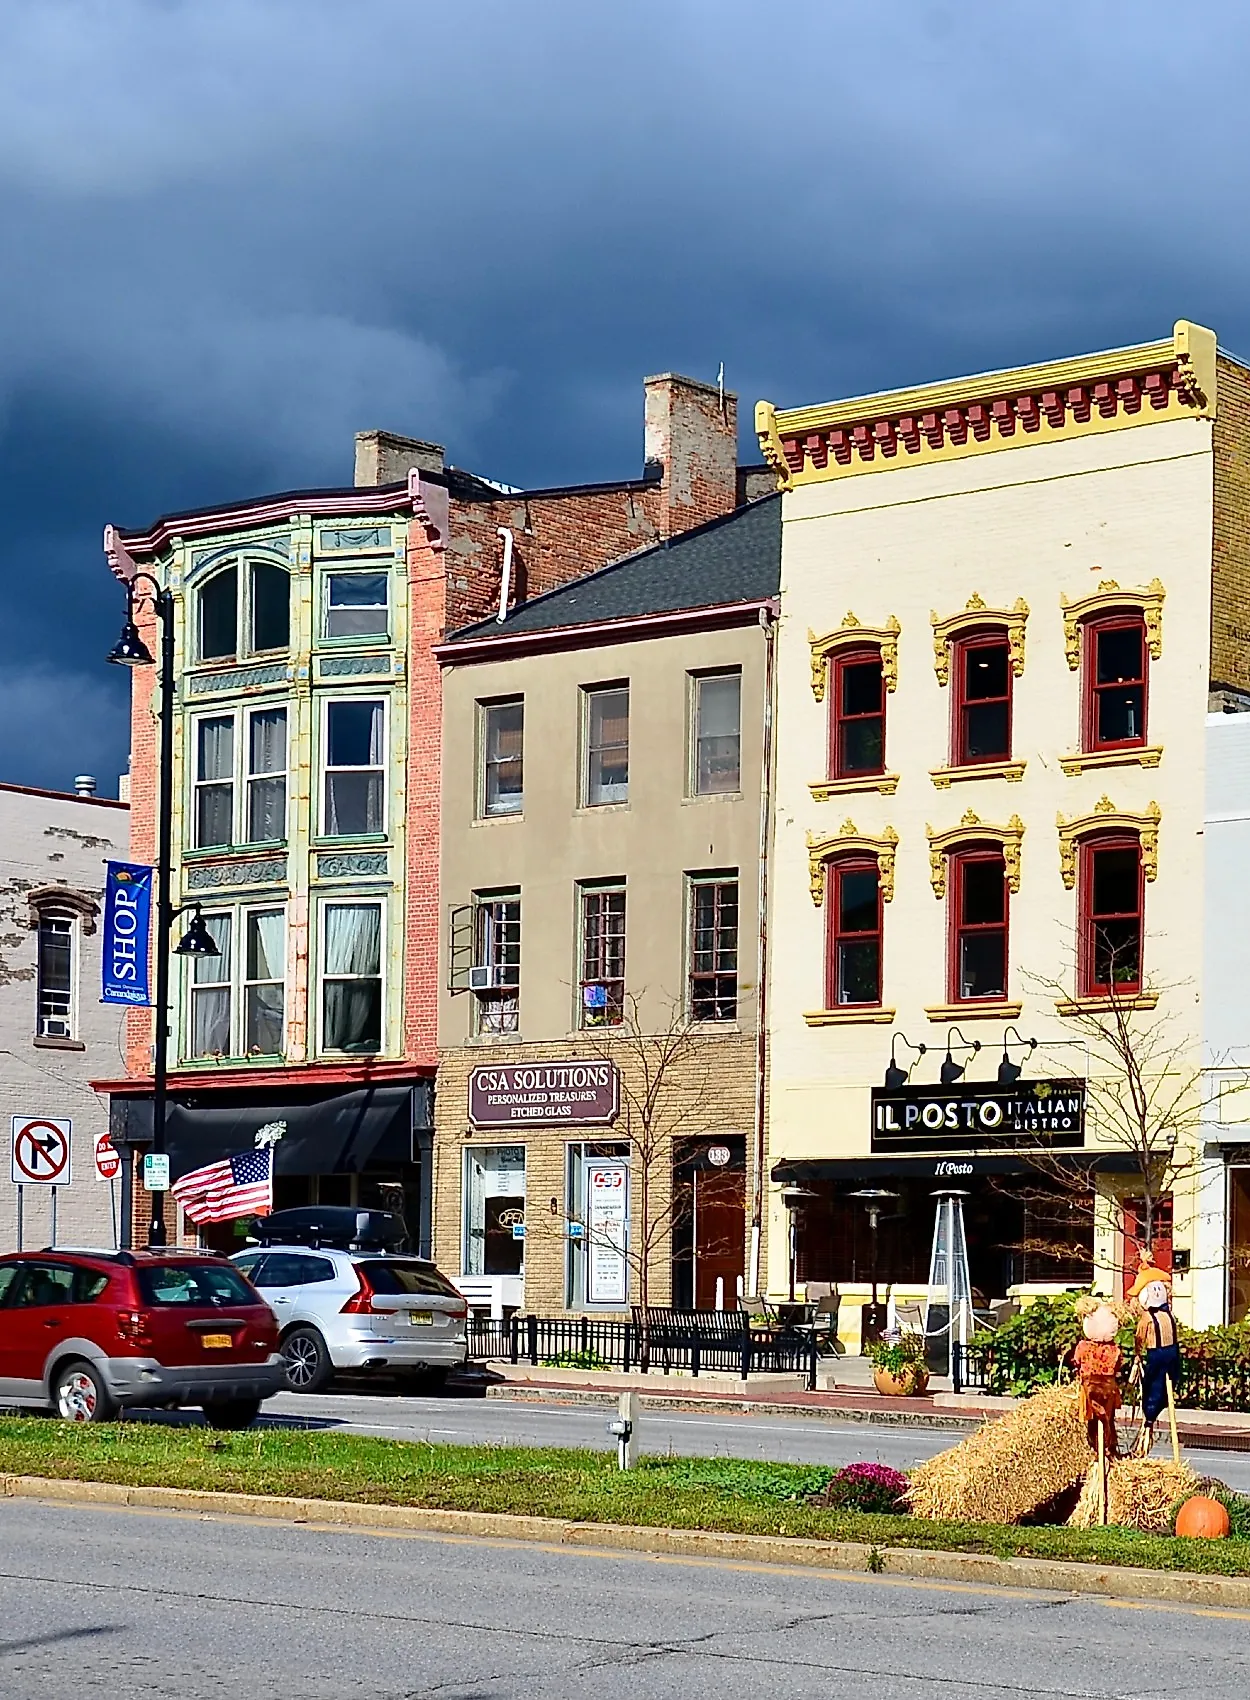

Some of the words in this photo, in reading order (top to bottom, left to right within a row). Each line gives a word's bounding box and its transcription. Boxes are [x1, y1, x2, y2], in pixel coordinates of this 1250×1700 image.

[113, 888, 137, 981] SHOP
[476, 1072, 509, 1091] CSA
[513, 1066, 609, 1090] SOLUTIONS
[488, 1092, 548, 1105] PERSONALIZED
[549, 1090, 597, 1102] TREASURES
[510, 1107, 544, 1118] ETCHED
[545, 1105, 572, 1117] GLASS
[877, 1104, 900, 1131] IL
[905, 1100, 1003, 1130] POSTO
[1007, 1098, 1079, 1115] ITALIAN
[98, 1142, 106, 1151] DO
[945, 1162, 974, 1176] Posto
